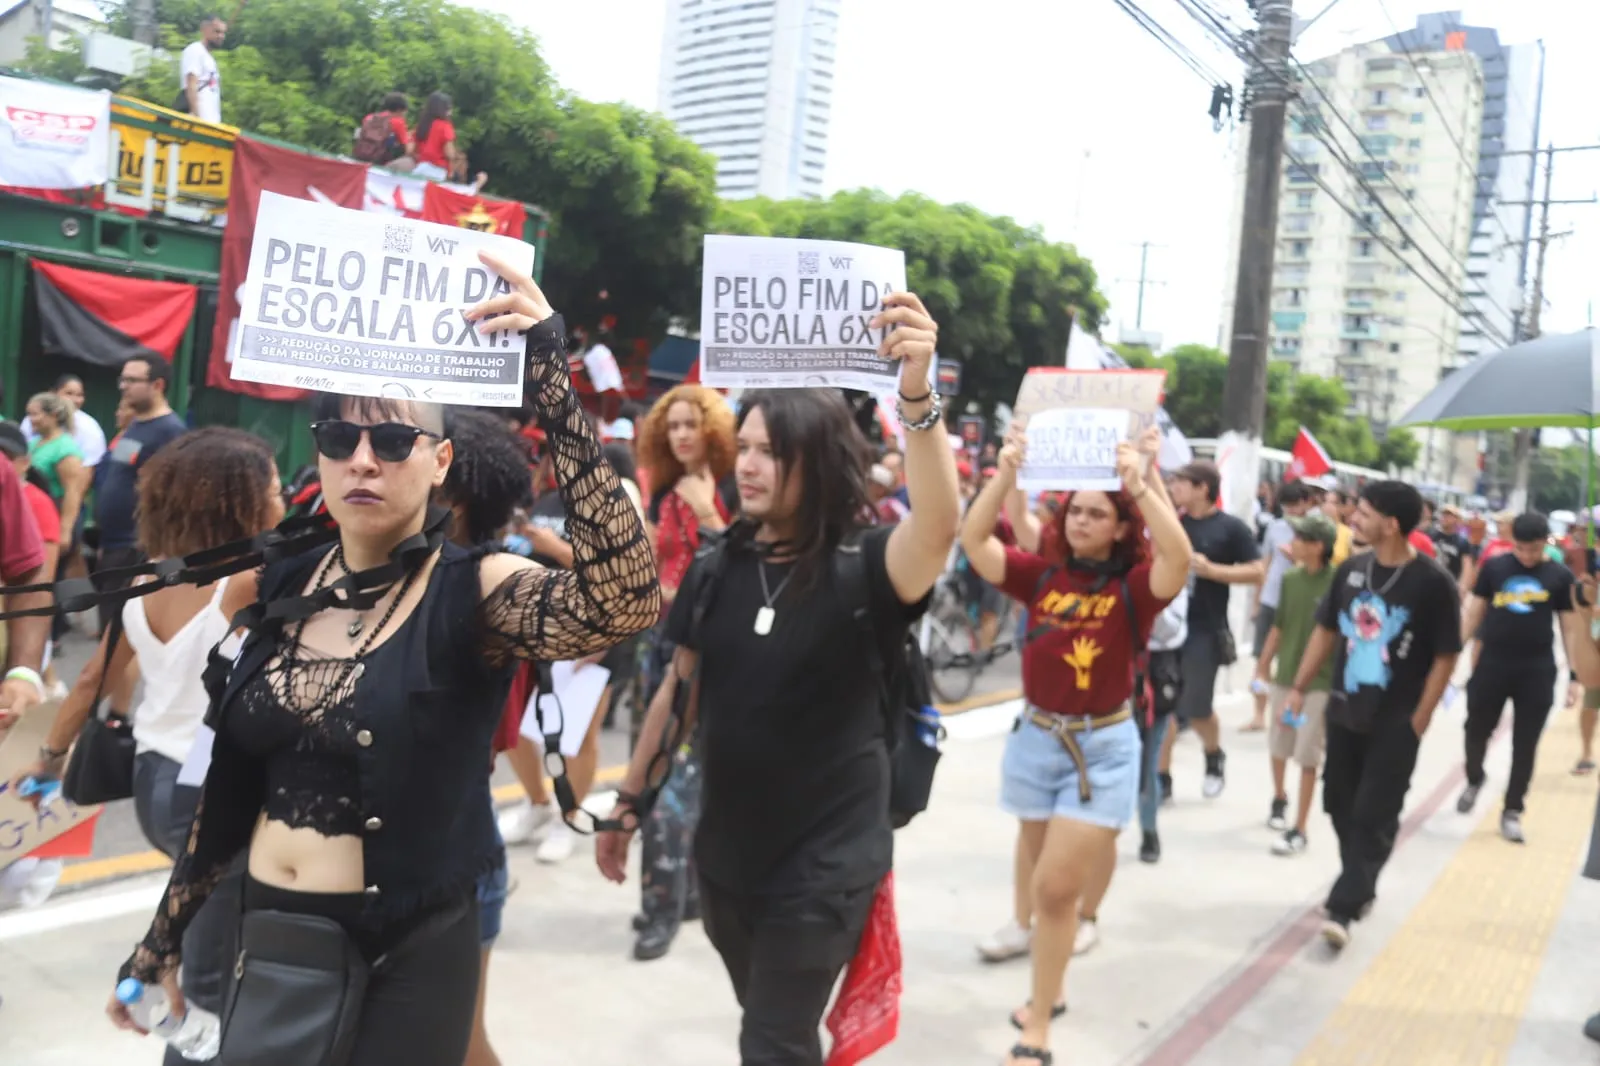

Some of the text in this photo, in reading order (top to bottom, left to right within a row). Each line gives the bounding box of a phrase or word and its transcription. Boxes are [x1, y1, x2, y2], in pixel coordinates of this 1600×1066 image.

[426, 234, 459, 256] VAT
[263, 238, 512, 304] PELO FIM DA
[829, 256, 854, 270] VAT
[714, 276, 787, 309] PELO
[799, 278, 849, 311] FIM
[256, 283, 417, 343] ESCALA
[713, 312, 828, 345] ESCALA
[261, 346, 501, 378] SEM REDUÇÃO DE SALÁRIOS E DIREITOS!
[281, 336, 506, 367] REDUÇÃO DA JORNADA DE TRABALHO
